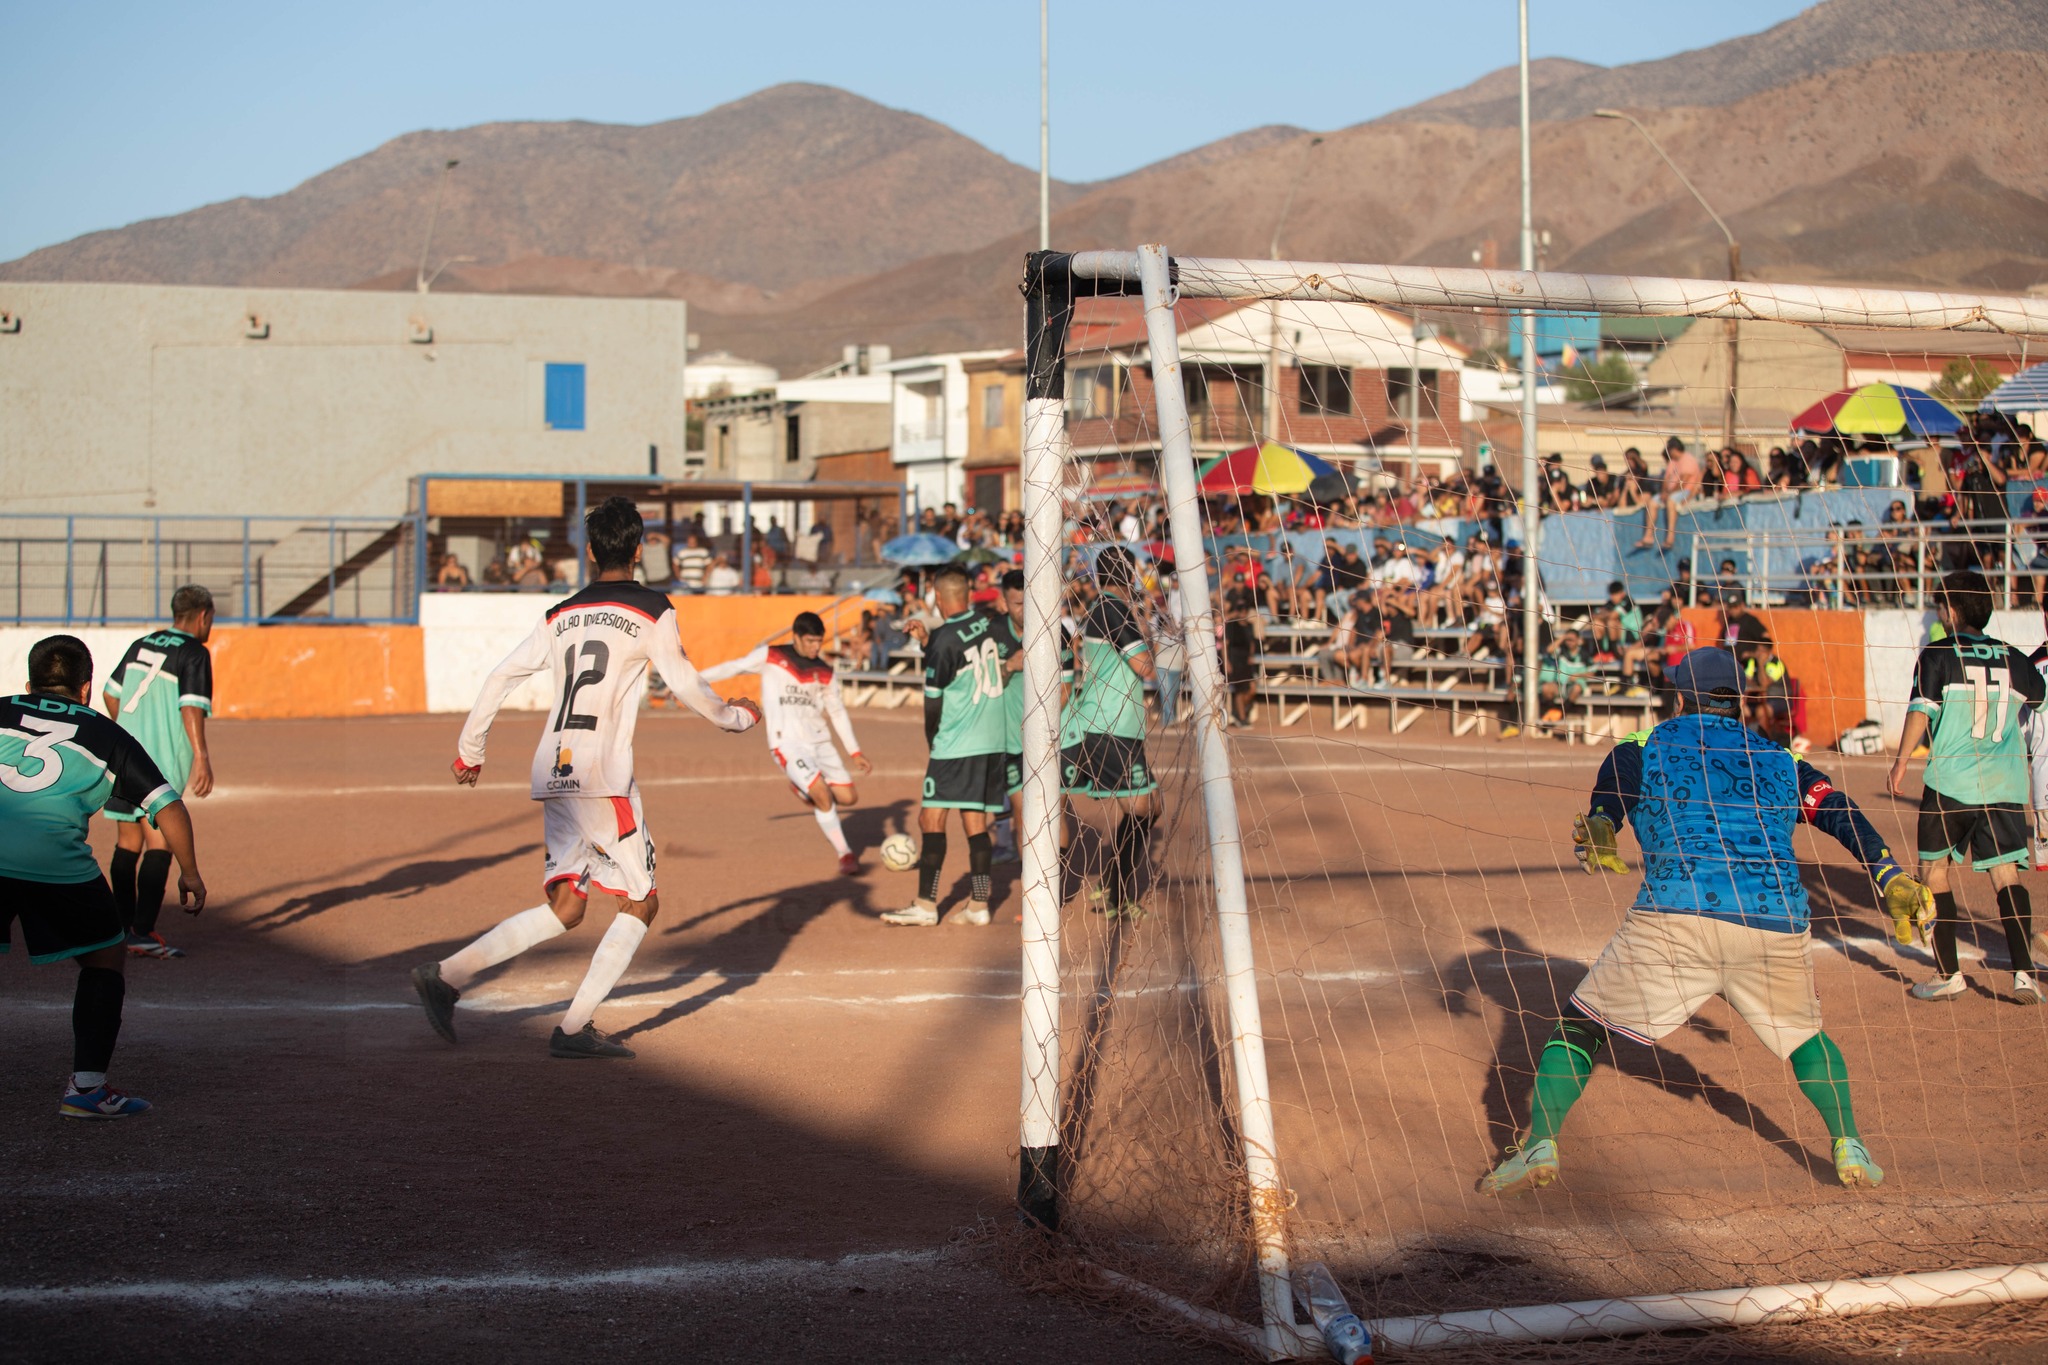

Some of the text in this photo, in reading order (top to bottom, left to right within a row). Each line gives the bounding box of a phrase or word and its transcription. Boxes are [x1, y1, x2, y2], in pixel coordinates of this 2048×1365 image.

[143, 634, 186, 648] LDF
[583, 612, 641, 638] INVERSIONES
[957, 617, 991, 643] LDF
[963, 637, 1003, 706] 10
[1953, 642, 2011, 662] LDF
[122, 648, 168, 714] 7
[554, 640, 610, 733] 12
[1965, 665, 2010, 743] 11
[11, 694, 98, 718] LDF
[0, 714, 80, 793] 3
